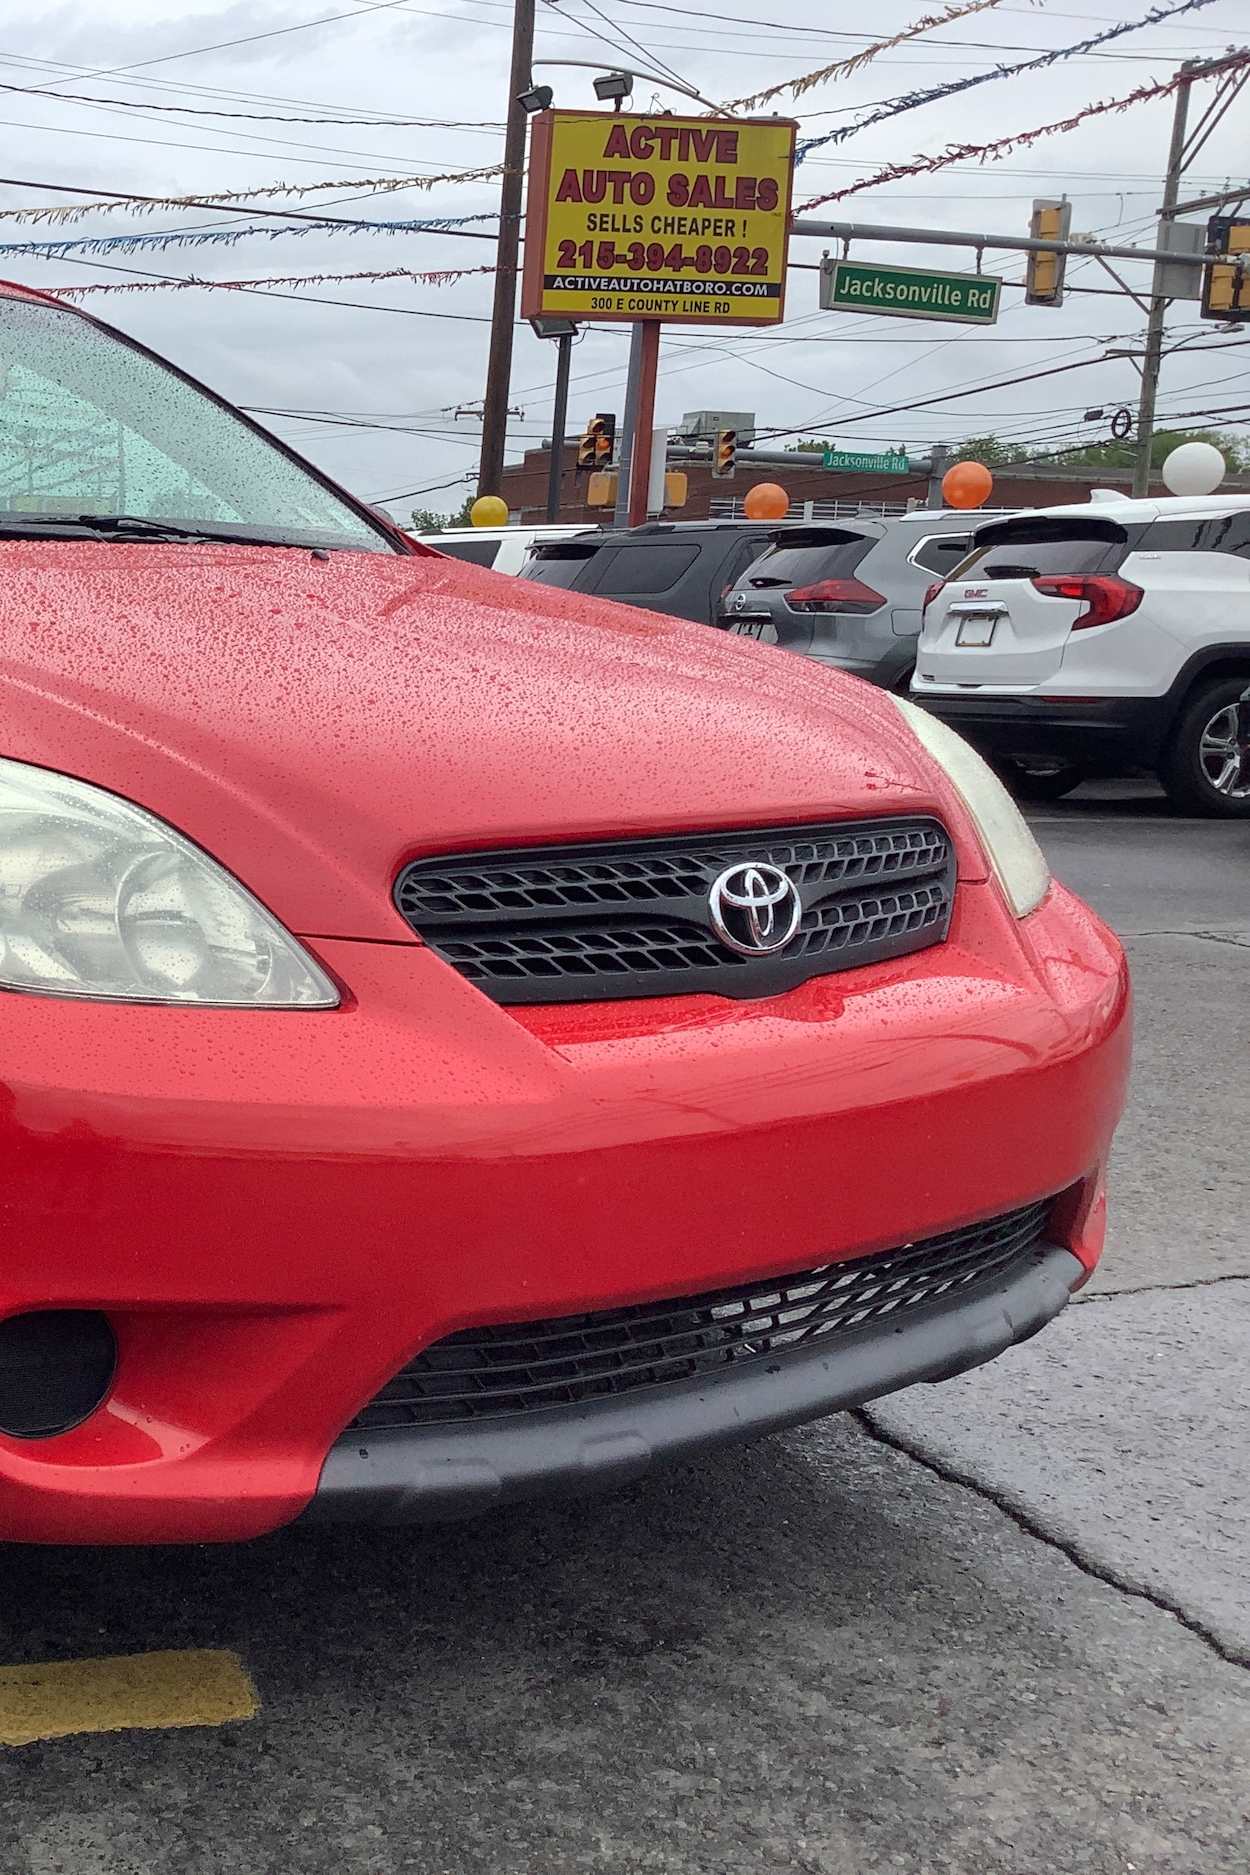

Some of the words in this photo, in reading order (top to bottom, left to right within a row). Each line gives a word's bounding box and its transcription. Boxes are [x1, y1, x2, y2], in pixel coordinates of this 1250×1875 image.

[602, 124, 739, 164] ACTIVE
[555, 168, 655, 206] AUTO
[666, 173, 779, 212] SALES
[586, 213, 644, 233] SELLS
[651, 215, 735, 237] CHEAPER
[556, 239, 769, 276] 215-394-8922
[553, 276, 768, 296] ACTIVEAUTOHATBORO.COM
[839, 275, 962, 306] Jacksonville
[967, 288, 992, 309] Rd
[591, 297, 613, 310] 300
[616, 298, 625, 310] E
[628, 298, 679, 312] COUNTY
[682, 300, 711, 313] LINE
[714, 301, 731, 314] RD
[828, 453, 890, 470] Jacksonville
[891, 456, 905, 471] Rd
[964, 588, 989, 599] GMC
